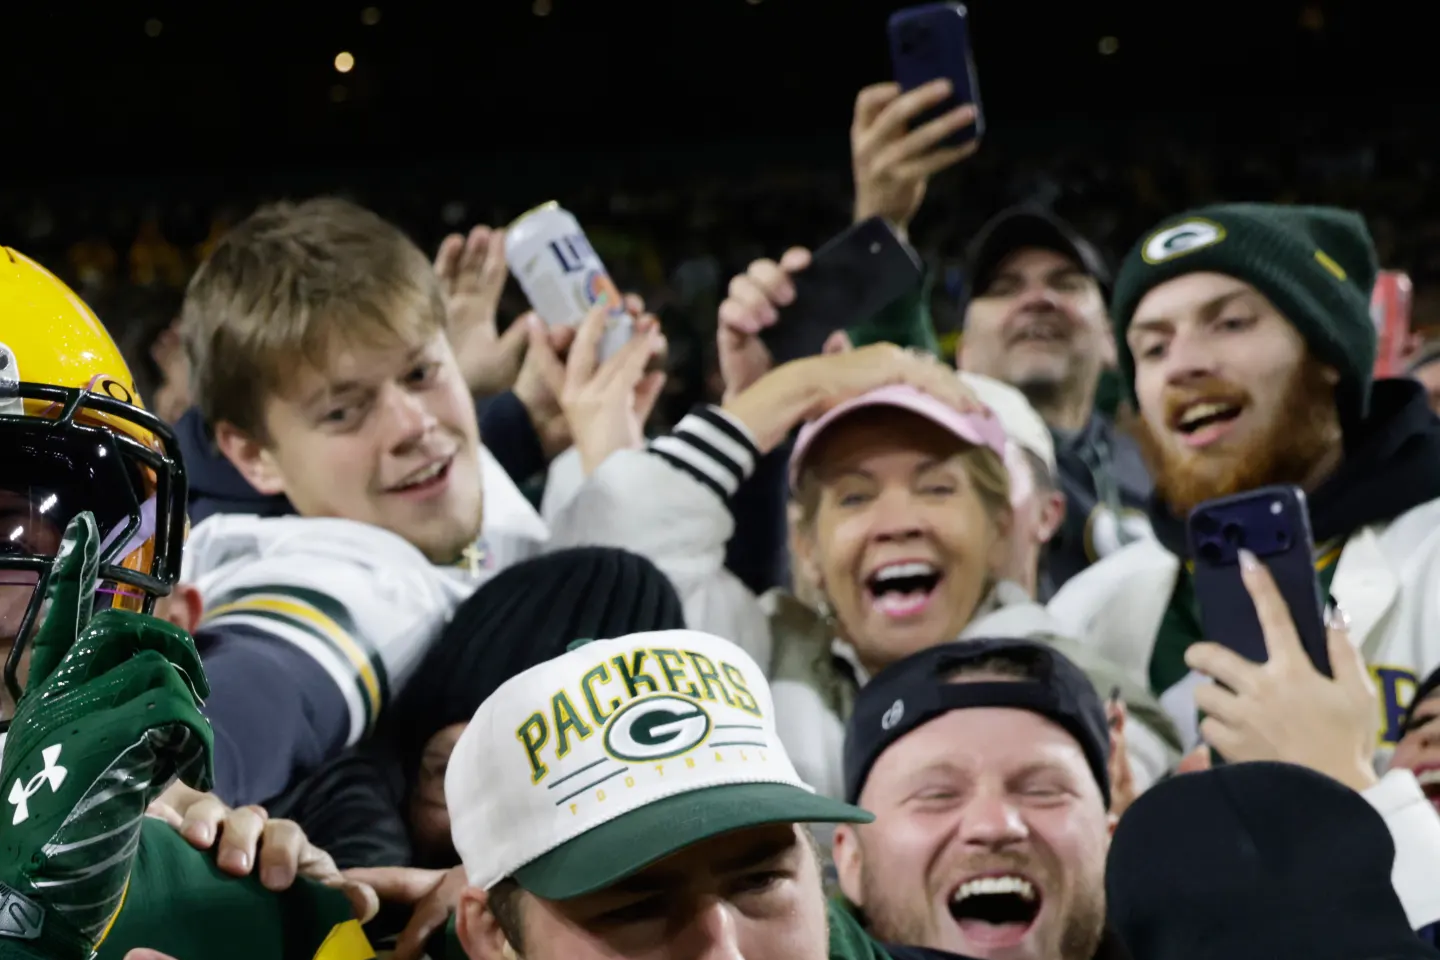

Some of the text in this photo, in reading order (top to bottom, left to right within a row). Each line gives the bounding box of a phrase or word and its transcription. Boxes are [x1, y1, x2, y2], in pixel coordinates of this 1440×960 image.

[515, 647, 763, 786] PACKERS
[604, 692, 711, 762] G
[569, 750, 767, 816] FOOTBALL
